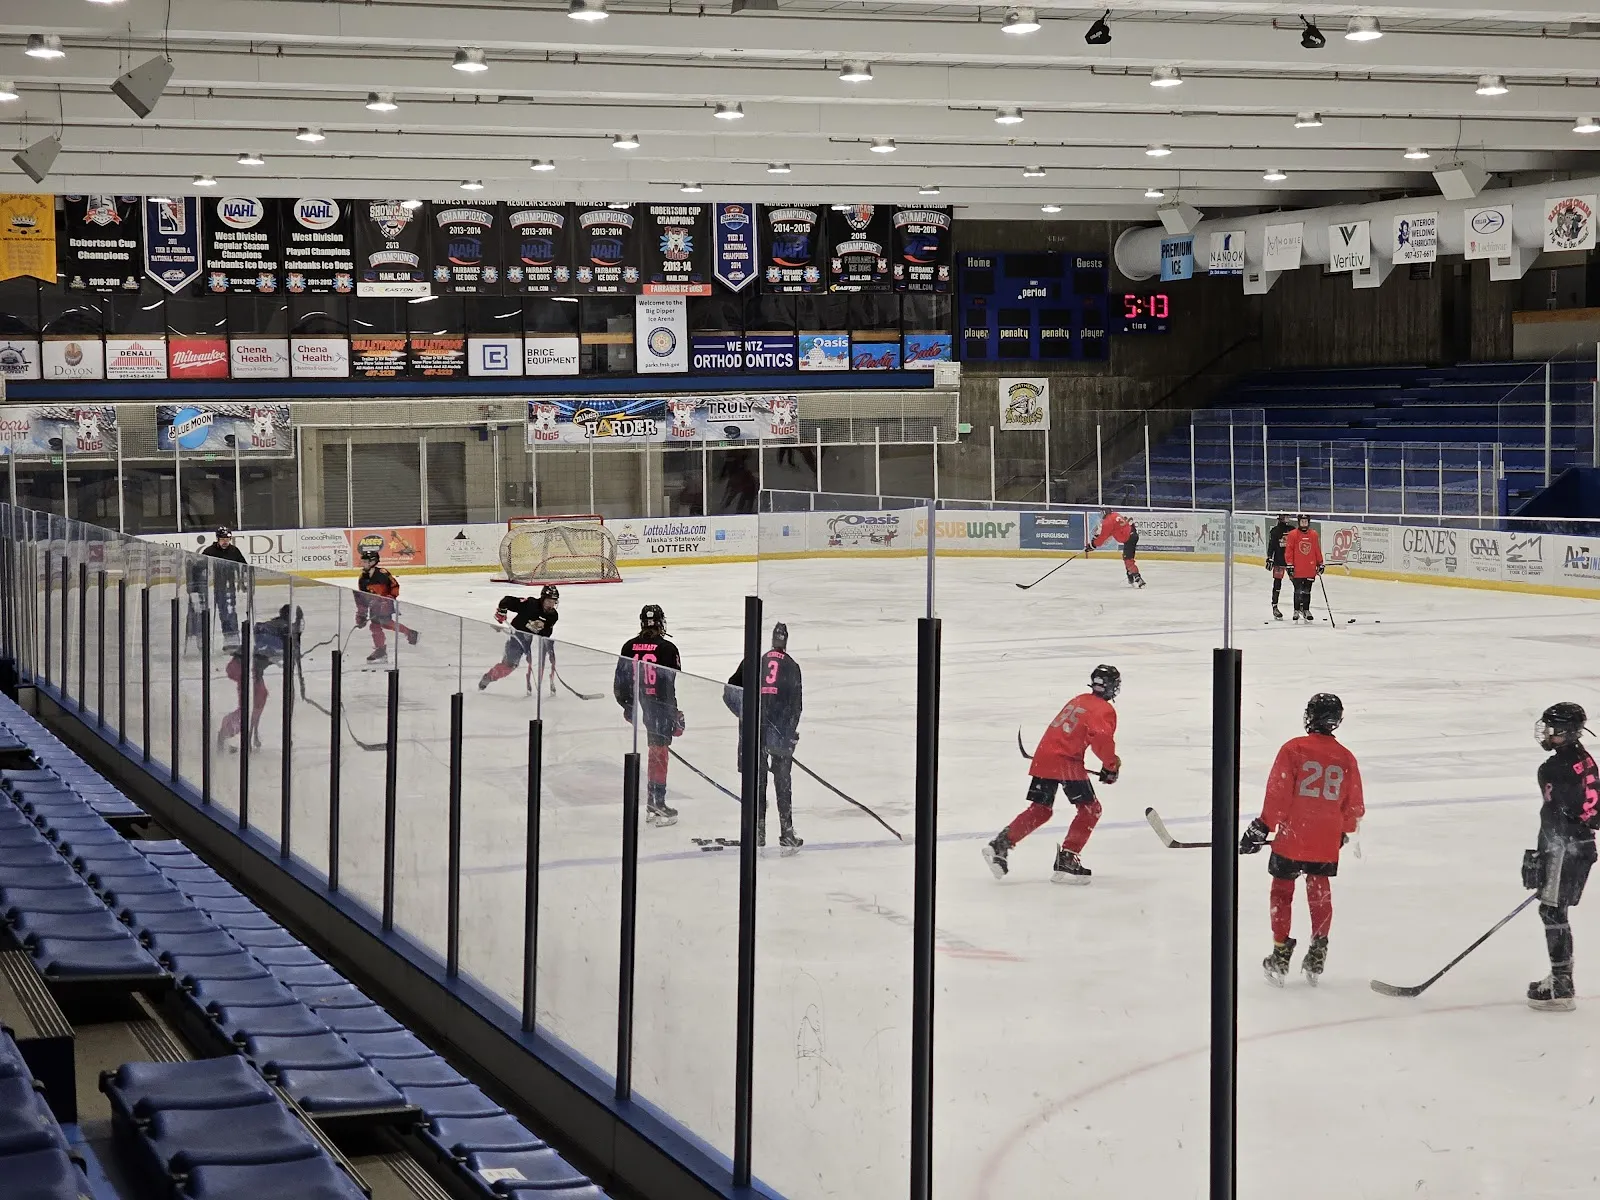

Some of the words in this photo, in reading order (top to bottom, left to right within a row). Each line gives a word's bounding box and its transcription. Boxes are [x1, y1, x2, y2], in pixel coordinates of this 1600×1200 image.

[224, 204, 257, 218] NAHL
[300, 204, 333, 218] NAHL
[370, 205, 414, 218] SHOWCASE
[650, 206, 688, 215] ROBERTSON
[688, 206, 701, 215] CUP
[772, 211, 812, 220] CHAMPIONS
[442, 211, 487, 223] CHAMPIONS
[514, 212, 558, 224] CHAMPIONS
[584, 212, 628, 224] CHAMPIONS
[657, 216, 694, 225] CHAMPIONS
[898, 212, 945, 225] CHAMPIONS
[1411, 218, 1435, 228] INTERIOR
[450, 226, 481, 235] 2013-2014
[522, 228, 552, 236] 2013-2014
[592, 228, 622, 236] 2013-2014
[774, 224, 810, 233] 2014-2015
[908, 225, 936, 234] 2015-2016
[1411, 228, 1435, 238] WELDING
[215, 232, 236, 241] West
[236, 232, 268, 241] Division
[292, 232, 312, 242] West
[313, 232, 344, 242] Division
[69, 238, 118, 248] Robertson
[118, 239, 136, 248] Cup
[214, 242, 242, 251] Regular
[243, 242, 270, 250] Season
[840, 242, 878, 252] CHAMPIONS
[1414, 238, 1436, 247] FABRICATION
[286, 247, 310, 256] Playoff
[312, 247, 350, 257] Champions
[1162, 240, 1192, 258] PREMIUM
[77, 251, 130, 260] Champions
[222, 250, 262, 260] Champions
[373, 252, 414, 263] CHAMPIONS
[844, 256, 876, 264] FAIRBANKS
[1210, 251, 1244, 262] NANOOK
[207, 260, 244, 269] Fairbanks
[244, 260, 257, 269] Ice
[258, 260, 278, 271] Dogs
[284, 260, 320, 270] Fairbanks
[322, 260, 334, 270] Ice
[334, 261, 354, 271] Dogs
[967, 258, 990, 268] Home
[1076, 258, 1102, 268] Guests
[1334, 254, 1364, 268] Veritiv
[452, 266, 480, 274] FAIRBANKS
[526, 266, 552, 274] FAIRBANKS
[663, 262, 692, 272] 2013-14
[849, 264, 858, 272] ICE
[908, 266, 934, 274] FAIRBANKS
[1171, 260, 1182, 275] ICE
[380, 272, 410, 280] NAHL.COM
[598, 274, 606, 282] ICE
[607, 274, 619, 282] DOGS
[89, 278, 120, 286] 2010-2011
[230, 278, 256, 286] 2011-2012
[308, 278, 332, 286] 2011-2012
[1022, 288, 1047, 298] period
[1132, 322, 1147, 330] time
[964, 328, 990, 340] player
[1000, 328, 1028, 339] penalty
[1042, 328, 1070, 339] penalty
[1080, 328, 1104, 339] player
[814, 338, 848, 348] Oasis
[236, 346, 267, 354] Chena
[298, 345, 328, 354] Chena
[527, 348, 554, 356] BRICE
[173, 349, 226, 365] Milwaukee
[240, 354, 272, 363] Health
[302, 354, 332, 362] Health
[853, 351, 896, 369] Party
[707, 402, 754, 415] TRULY
[0, 420, 30, 431] oors
[190, 414, 212, 432] MOON
[586, 418, 658, 438] HARDER
[672, 426, 696, 438] DOGS
[770, 424, 795, 435] DOGS
[534, 430, 560, 440] DOGS
[76, 438, 103, 451] DOGS
[252, 434, 277, 448] DOGS
[844, 514, 900, 525] Oasis
[643, 522, 706, 536] LottoAlaska.com
[936, 521, 1016, 538] SUBWAY
[1153, 529, 1188, 537] SPECIALISTS
[1402, 528, 1457, 556] GENE'S
[1470, 538, 1499, 556] GNA
[651, 544, 699, 554] LOTTERY
[251, 556, 293, 564] FFING
[766, 660, 778, 684] 3
[1299, 760, 1344, 800] 28
